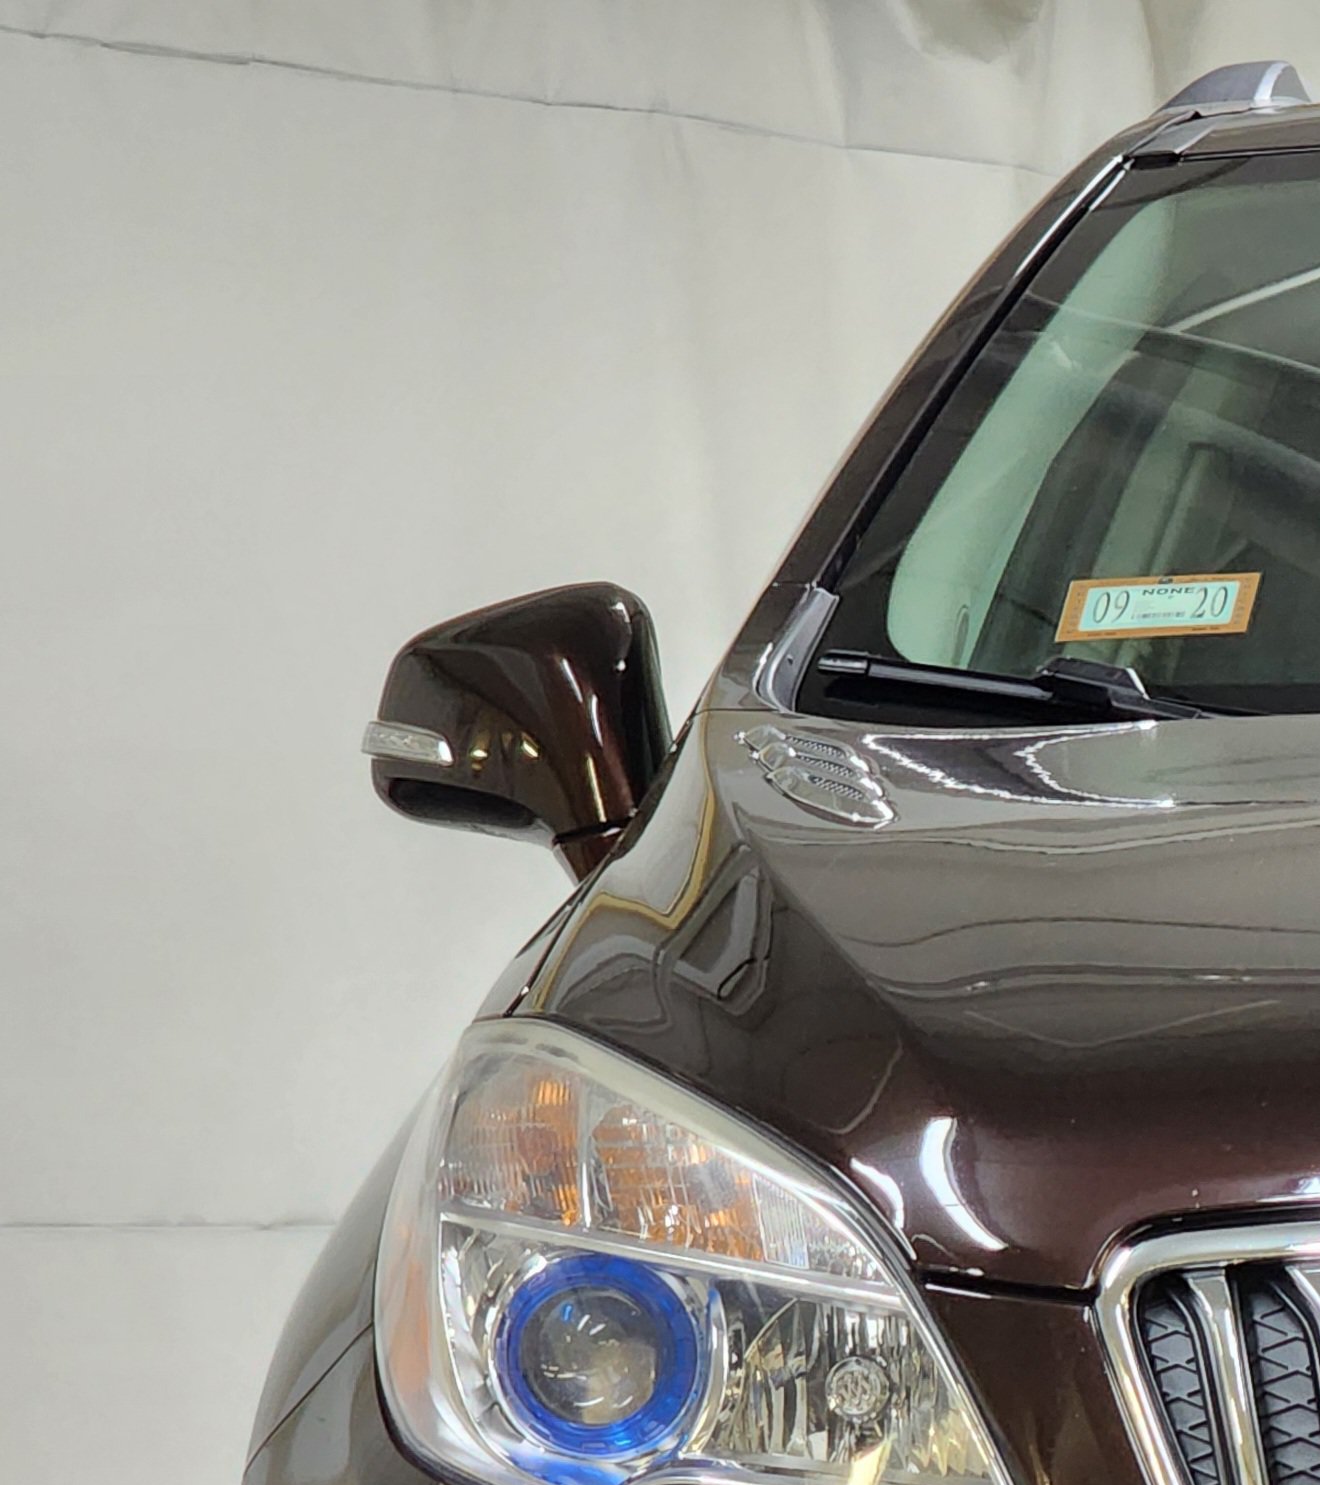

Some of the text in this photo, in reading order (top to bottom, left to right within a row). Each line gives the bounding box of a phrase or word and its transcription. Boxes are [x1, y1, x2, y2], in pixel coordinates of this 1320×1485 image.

[1092, 591, 1131, 624] 09
[1142, 587, 1195, 597] NONE
[1191, 586, 1229, 618] 20
